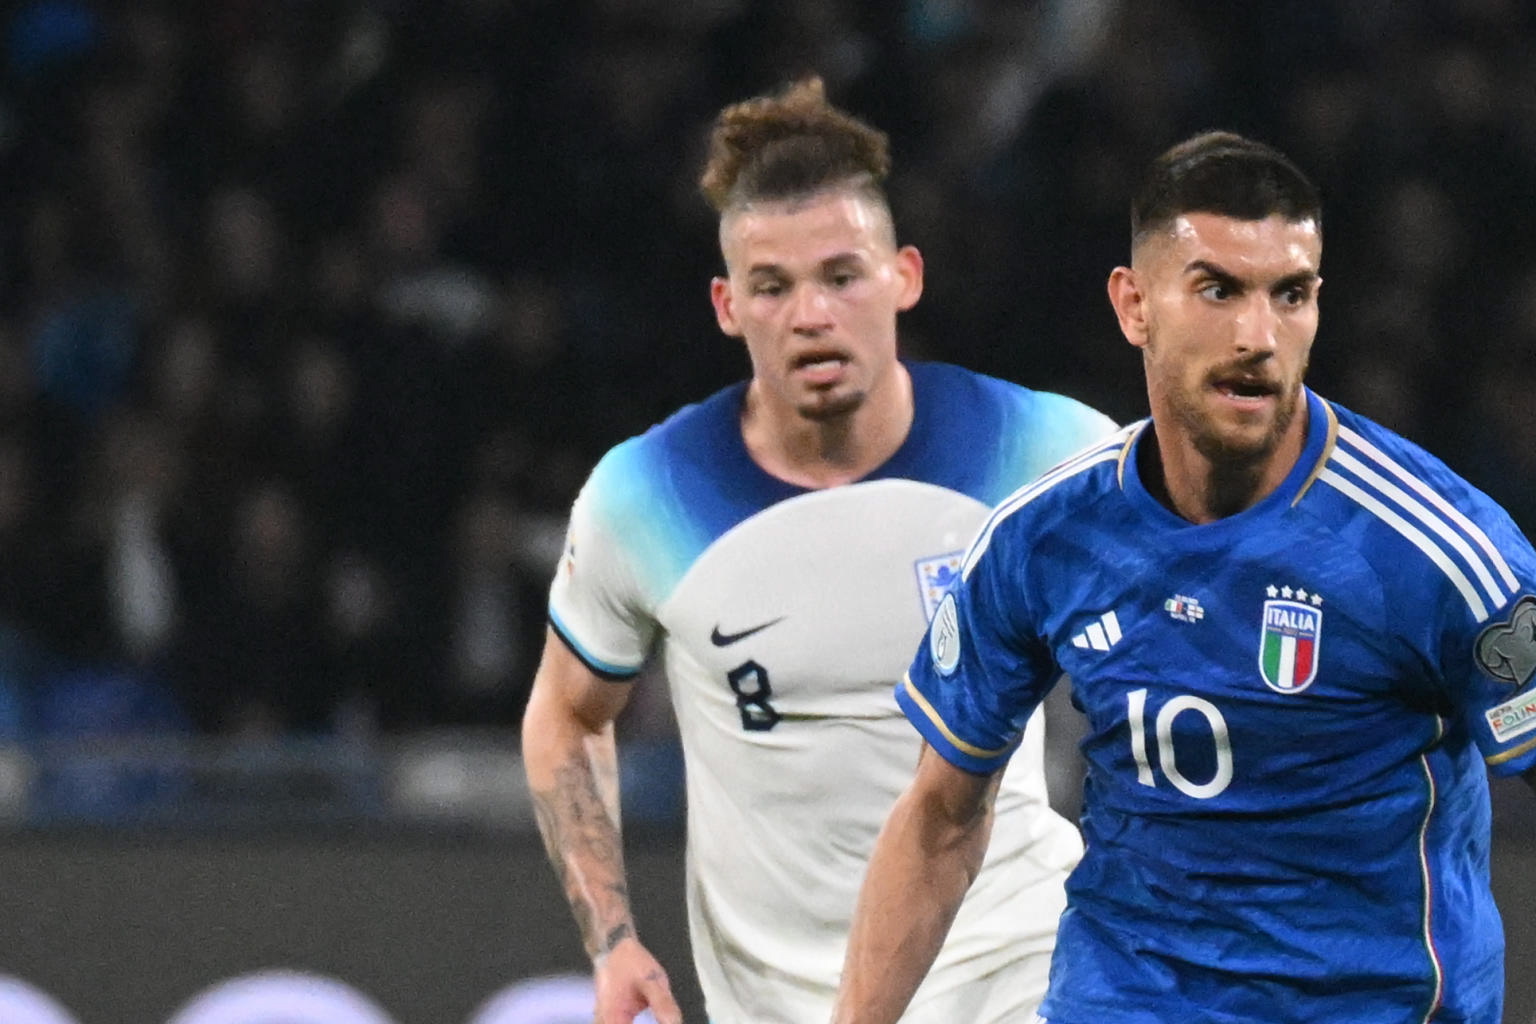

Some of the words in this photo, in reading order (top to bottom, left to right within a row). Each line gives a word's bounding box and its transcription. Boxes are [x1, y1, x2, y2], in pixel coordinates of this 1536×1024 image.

[1267, 607, 1316, 632] ITALIA
[727, 659, 781, 732] 8
[1126, 687, 1234, 799] 10
